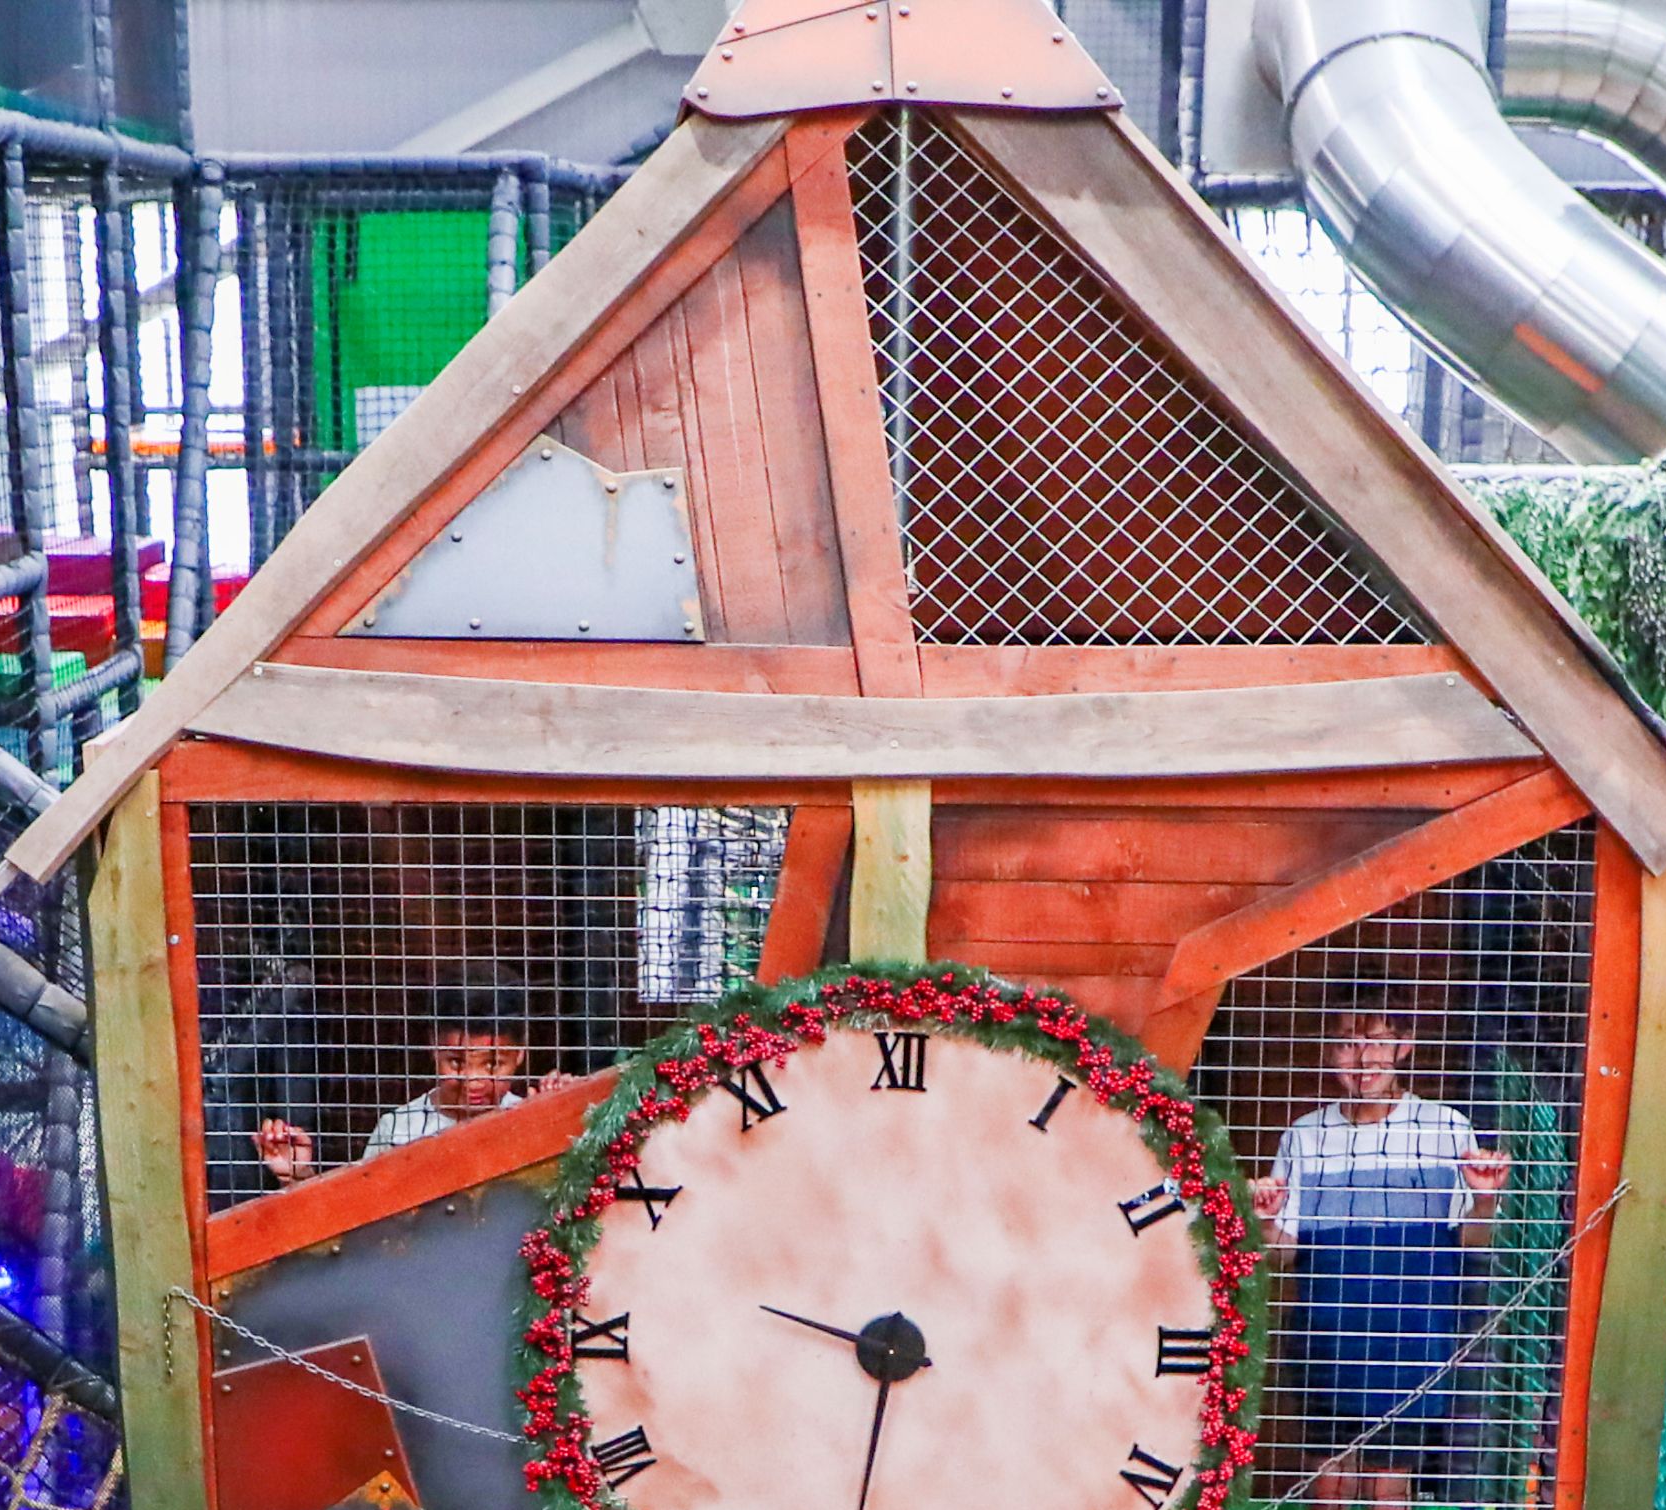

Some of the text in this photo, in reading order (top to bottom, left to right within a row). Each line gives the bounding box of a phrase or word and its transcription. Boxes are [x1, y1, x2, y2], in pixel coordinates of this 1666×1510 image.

[871, 1032, 930, 1092] XII
[717, 1062, 787, 1132] XI
[1029, 1075, 1076, 1132] I
[614, 1167, 683, 1231] X
[1118, 1177, 1186, 1237] II
[571, 1311, 630, 1364] IX
[1155, 1325, 1212, 1378] III
[590, 1425, 658, 1492] VIII
